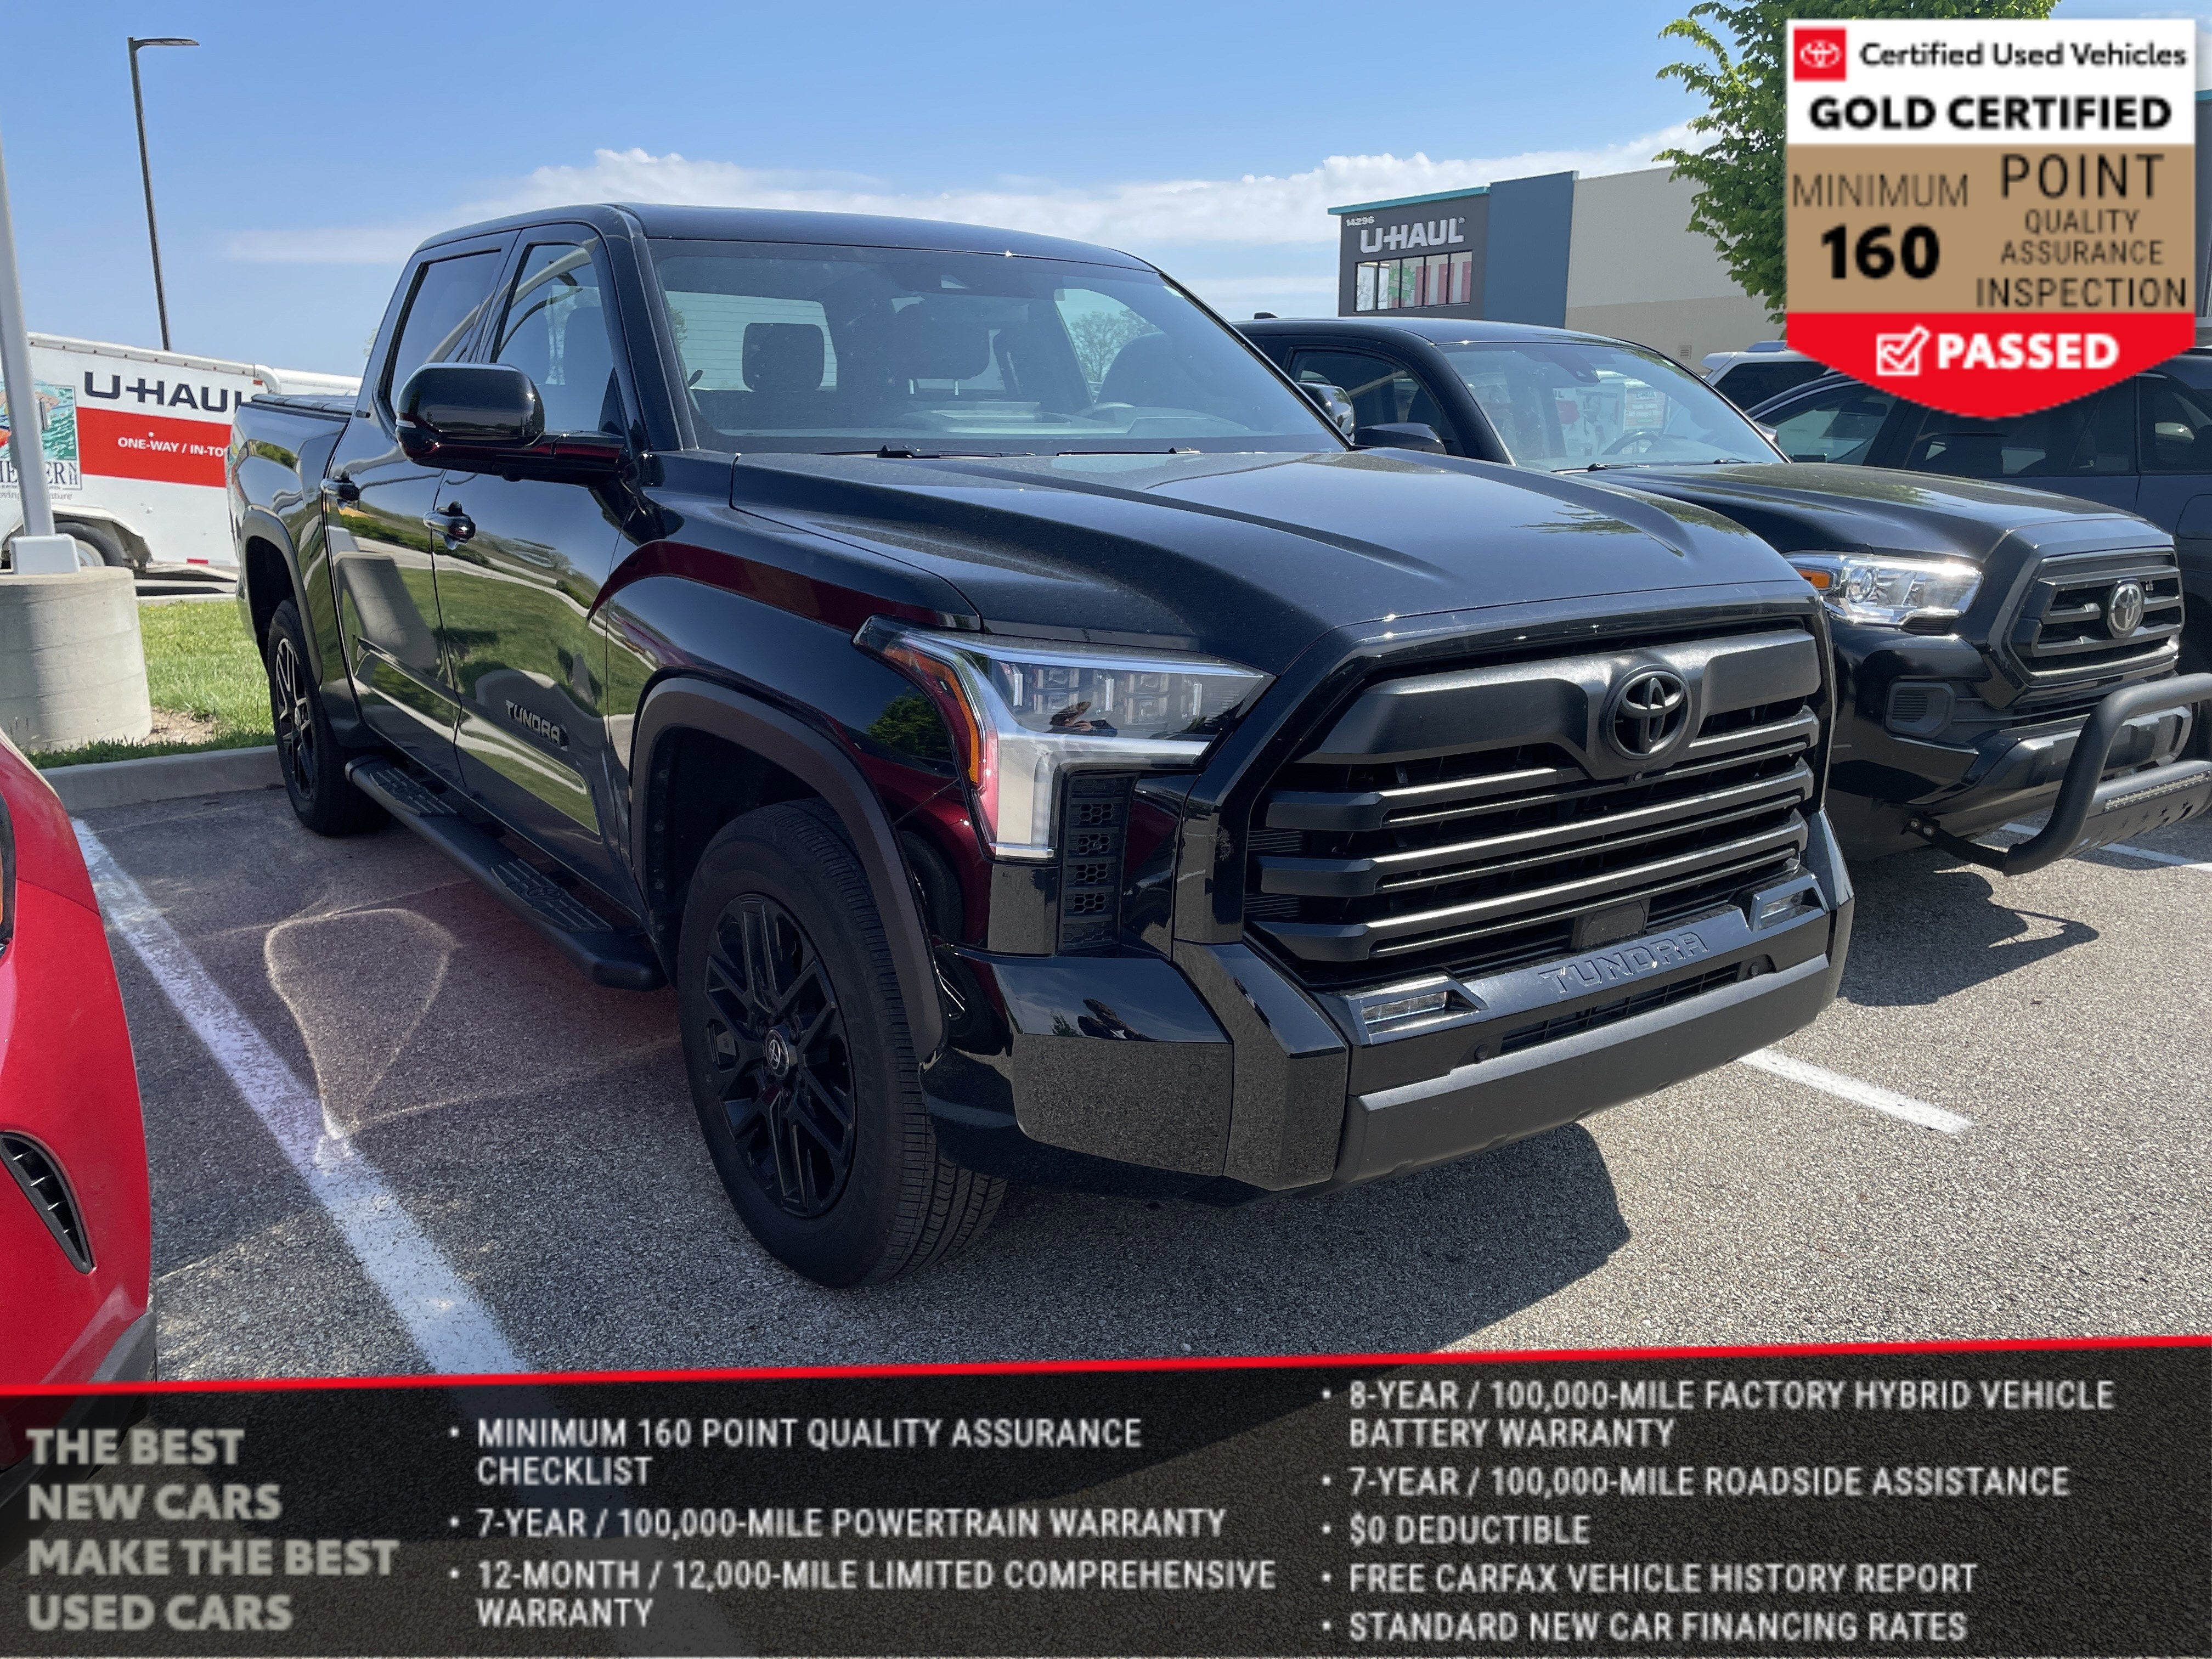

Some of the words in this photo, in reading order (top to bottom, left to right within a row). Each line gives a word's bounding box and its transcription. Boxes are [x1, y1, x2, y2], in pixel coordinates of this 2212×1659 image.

[1346, 216, 1375, 227] 14296
[1360, 218, 1465, 253] U-HAUL
[117, 437, 179, 453] ONE-WAY
[190, 444, 226, 458] IN-TO
[506, 699, 561, 746] TUNDRA
[1537, 932, 1711, 994] TUNDRA
